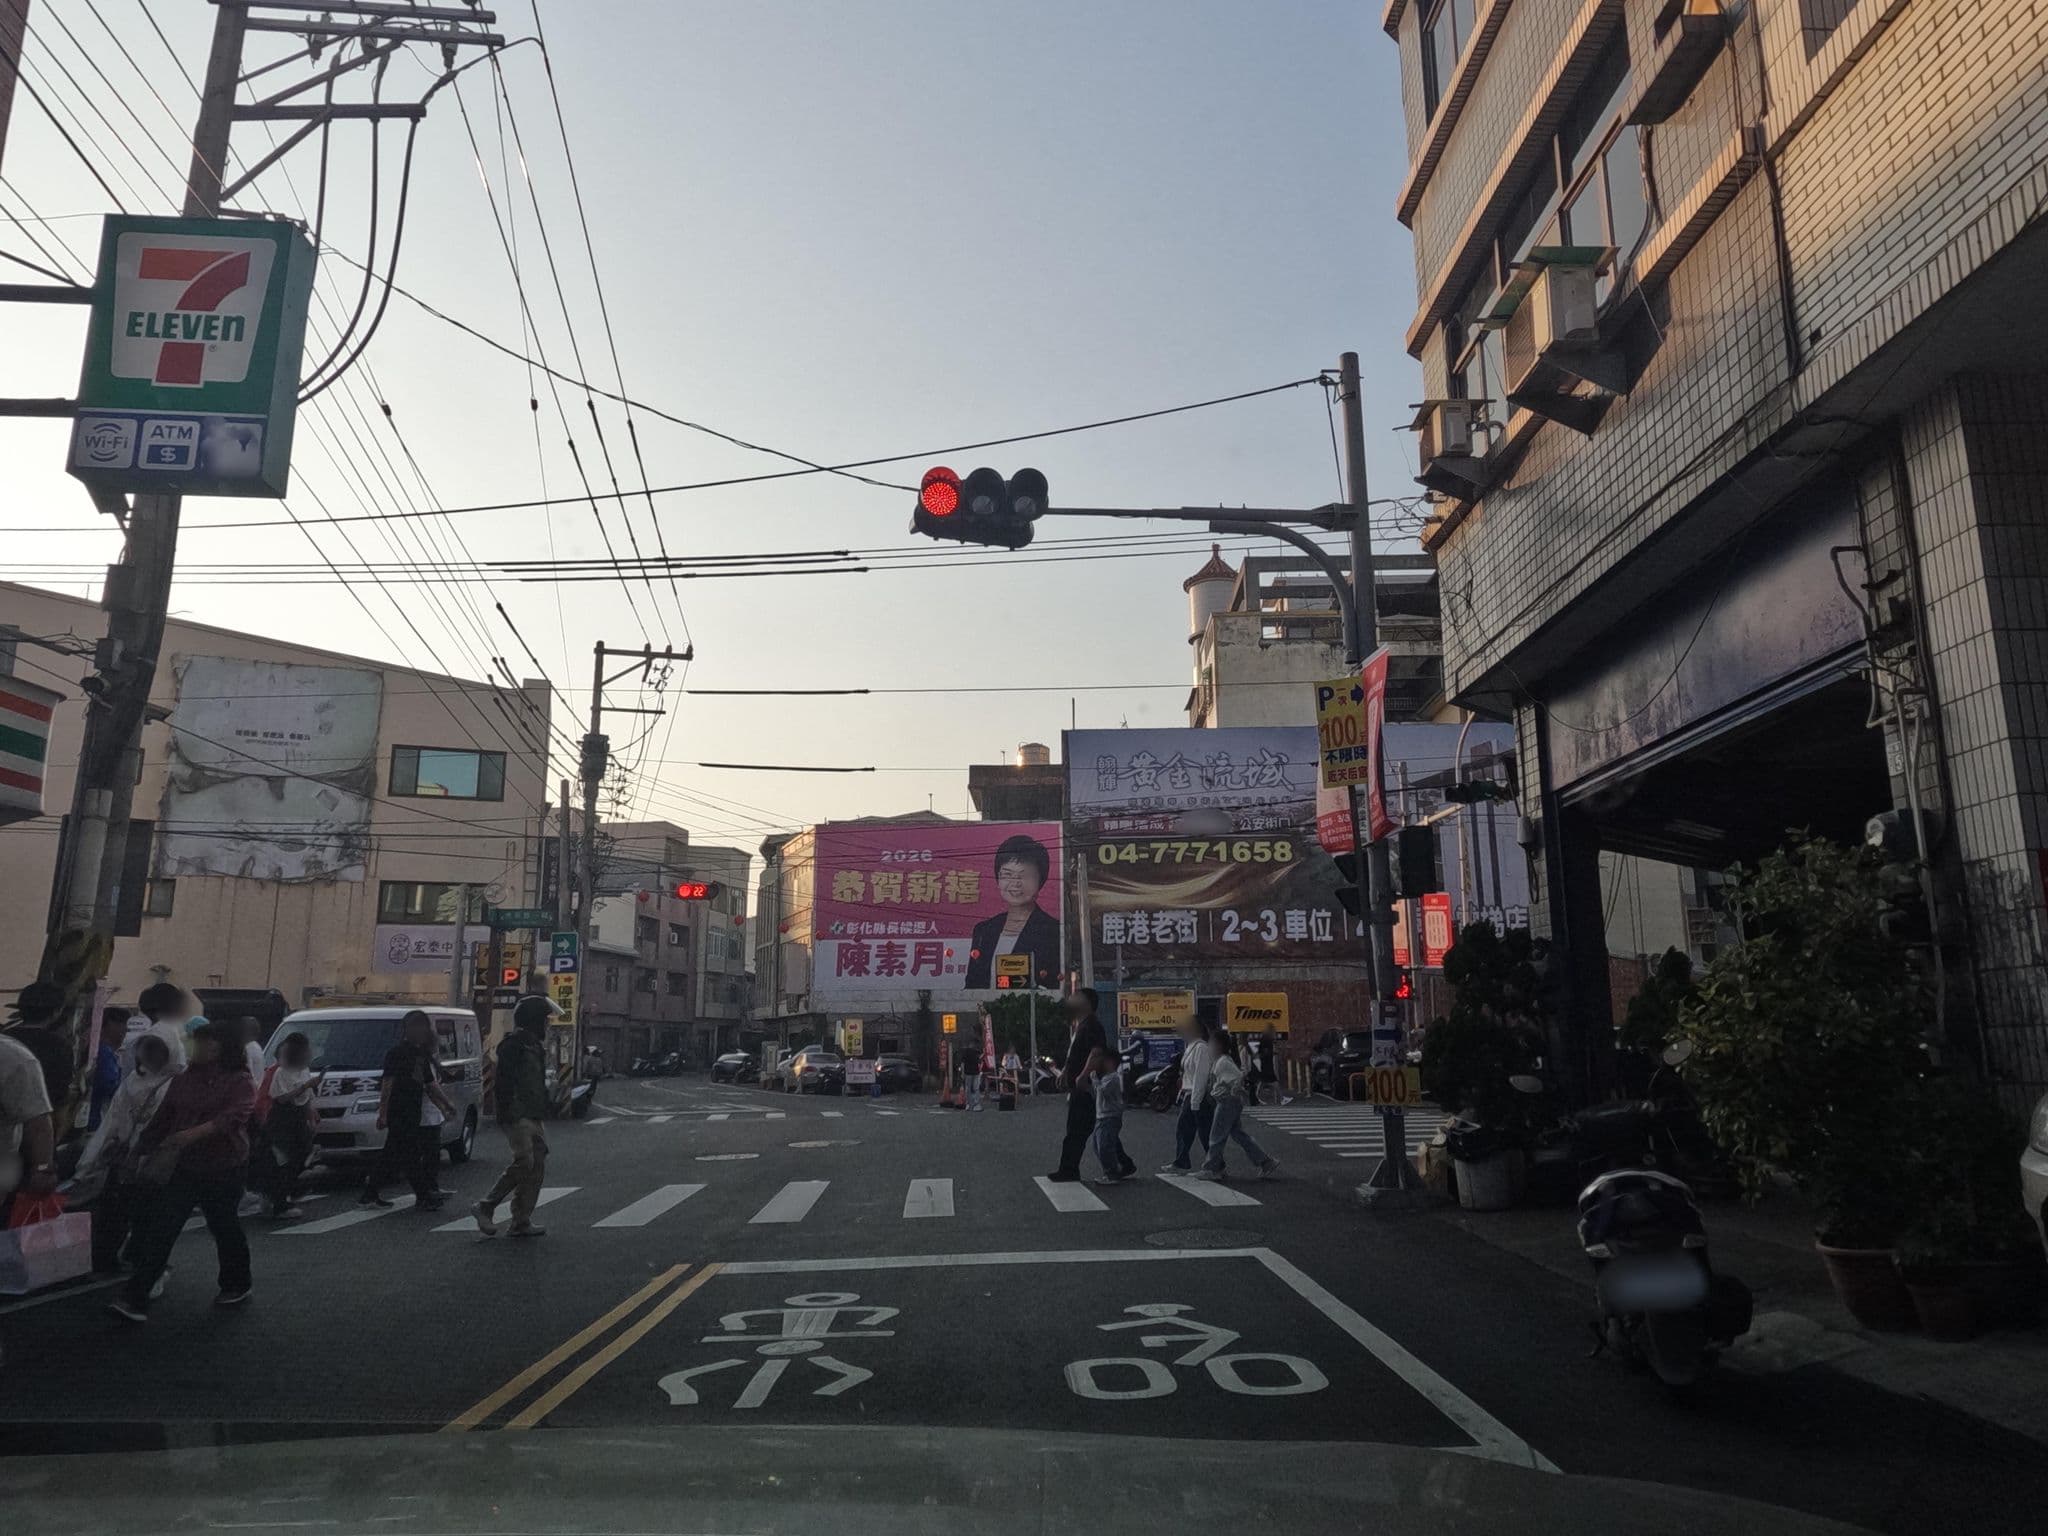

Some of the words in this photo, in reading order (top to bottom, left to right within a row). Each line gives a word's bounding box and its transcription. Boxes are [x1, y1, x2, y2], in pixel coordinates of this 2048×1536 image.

[150, 424, 194, 441] ATM
[84, 434, 129, 450] Wi-Fi
[1318, 686, 1335, 712] P
[1324, 745, 1368, 765] 不限時
[880, 850, 934, 862] 2026
[1097, 840, 1294, 865] 04-7771658
[693, 886, 704, 897] 22
[831, 870, 982, 905] 恭賀新禧
[846, 921, 940, 935] 彰化縣長候選人
[1102, 910, 1199, 944] 鹿港老街
[554, 957, 574, 972] P
[835, 940, 945, 978] 陳素月
[503, 969, 519, 985] P
[1234, 1005, 1282, 1020] Times
[316, 1077, 379, 1097] 保全
